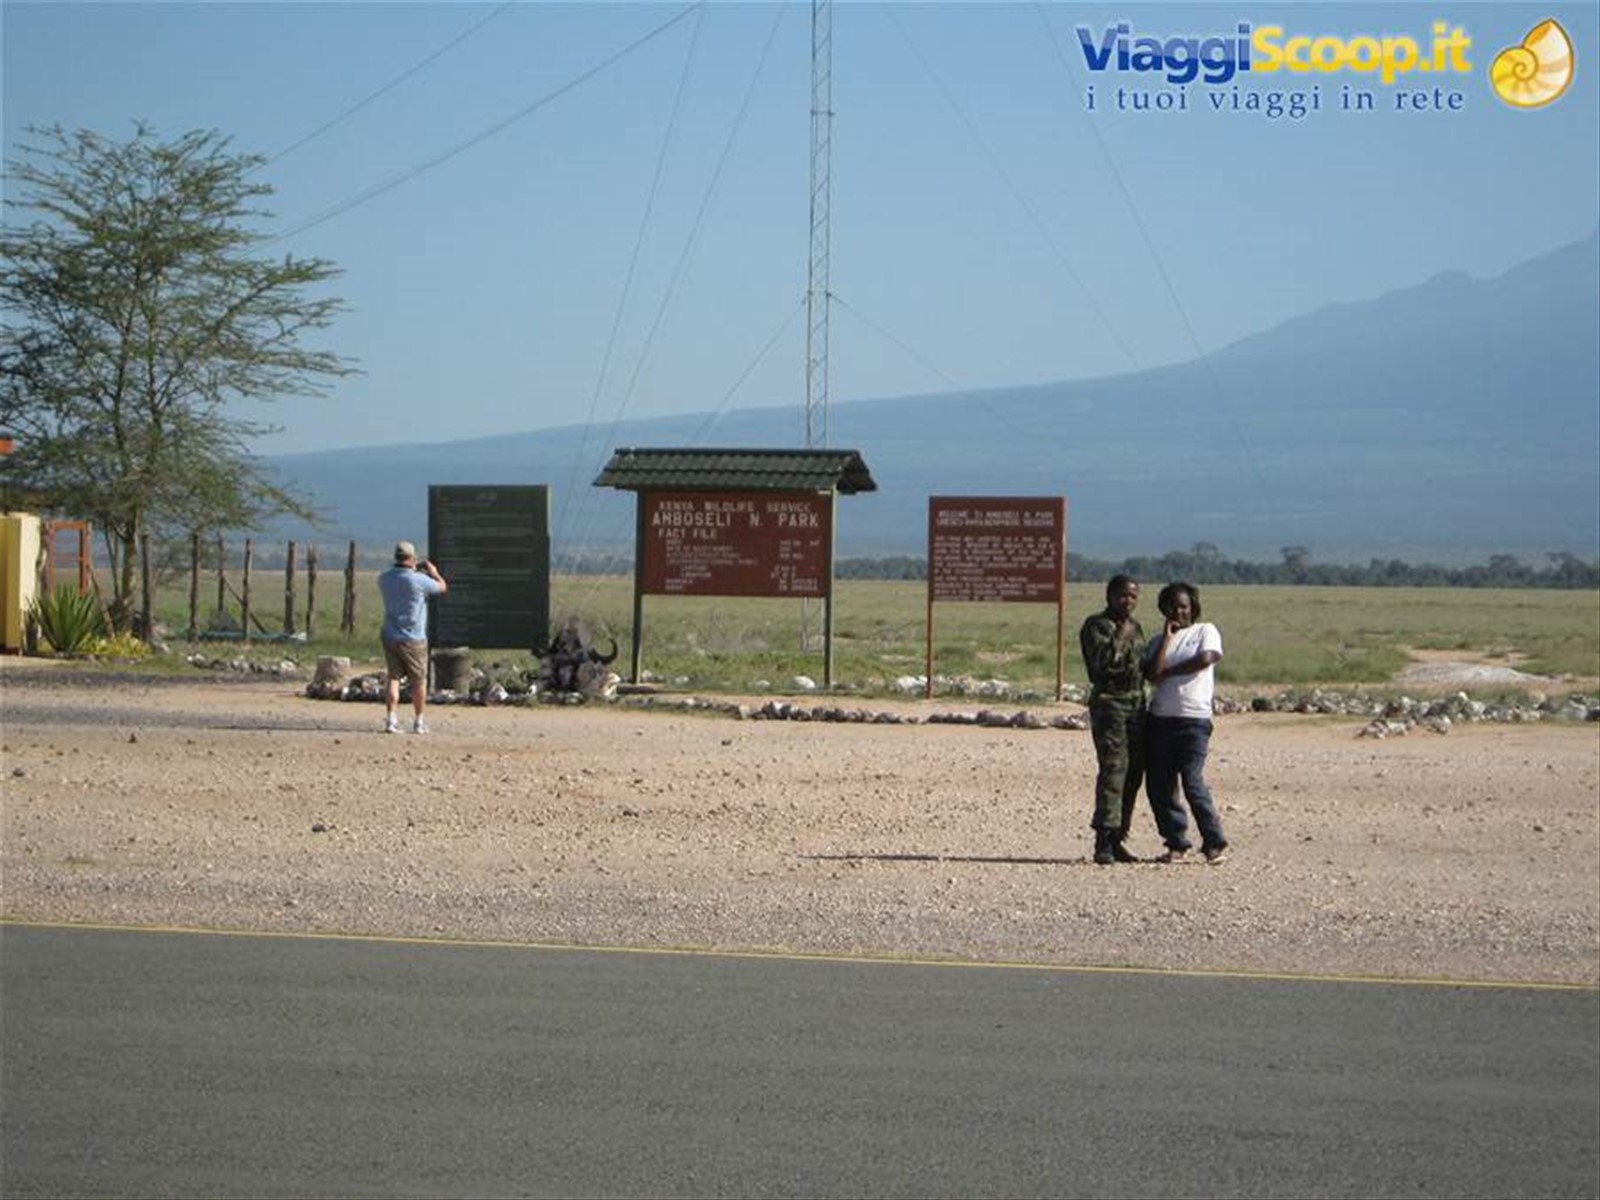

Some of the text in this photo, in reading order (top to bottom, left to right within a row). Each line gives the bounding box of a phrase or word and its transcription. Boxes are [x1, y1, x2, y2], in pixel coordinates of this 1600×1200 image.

[658, 501, 812, 513] KENYA WILDLIFE SERVICE
[652, 512, 731, 526] AMBOSELI
[778, 513, 819, 527] PARK
[658, 528, 718, 539] FACT FILE
